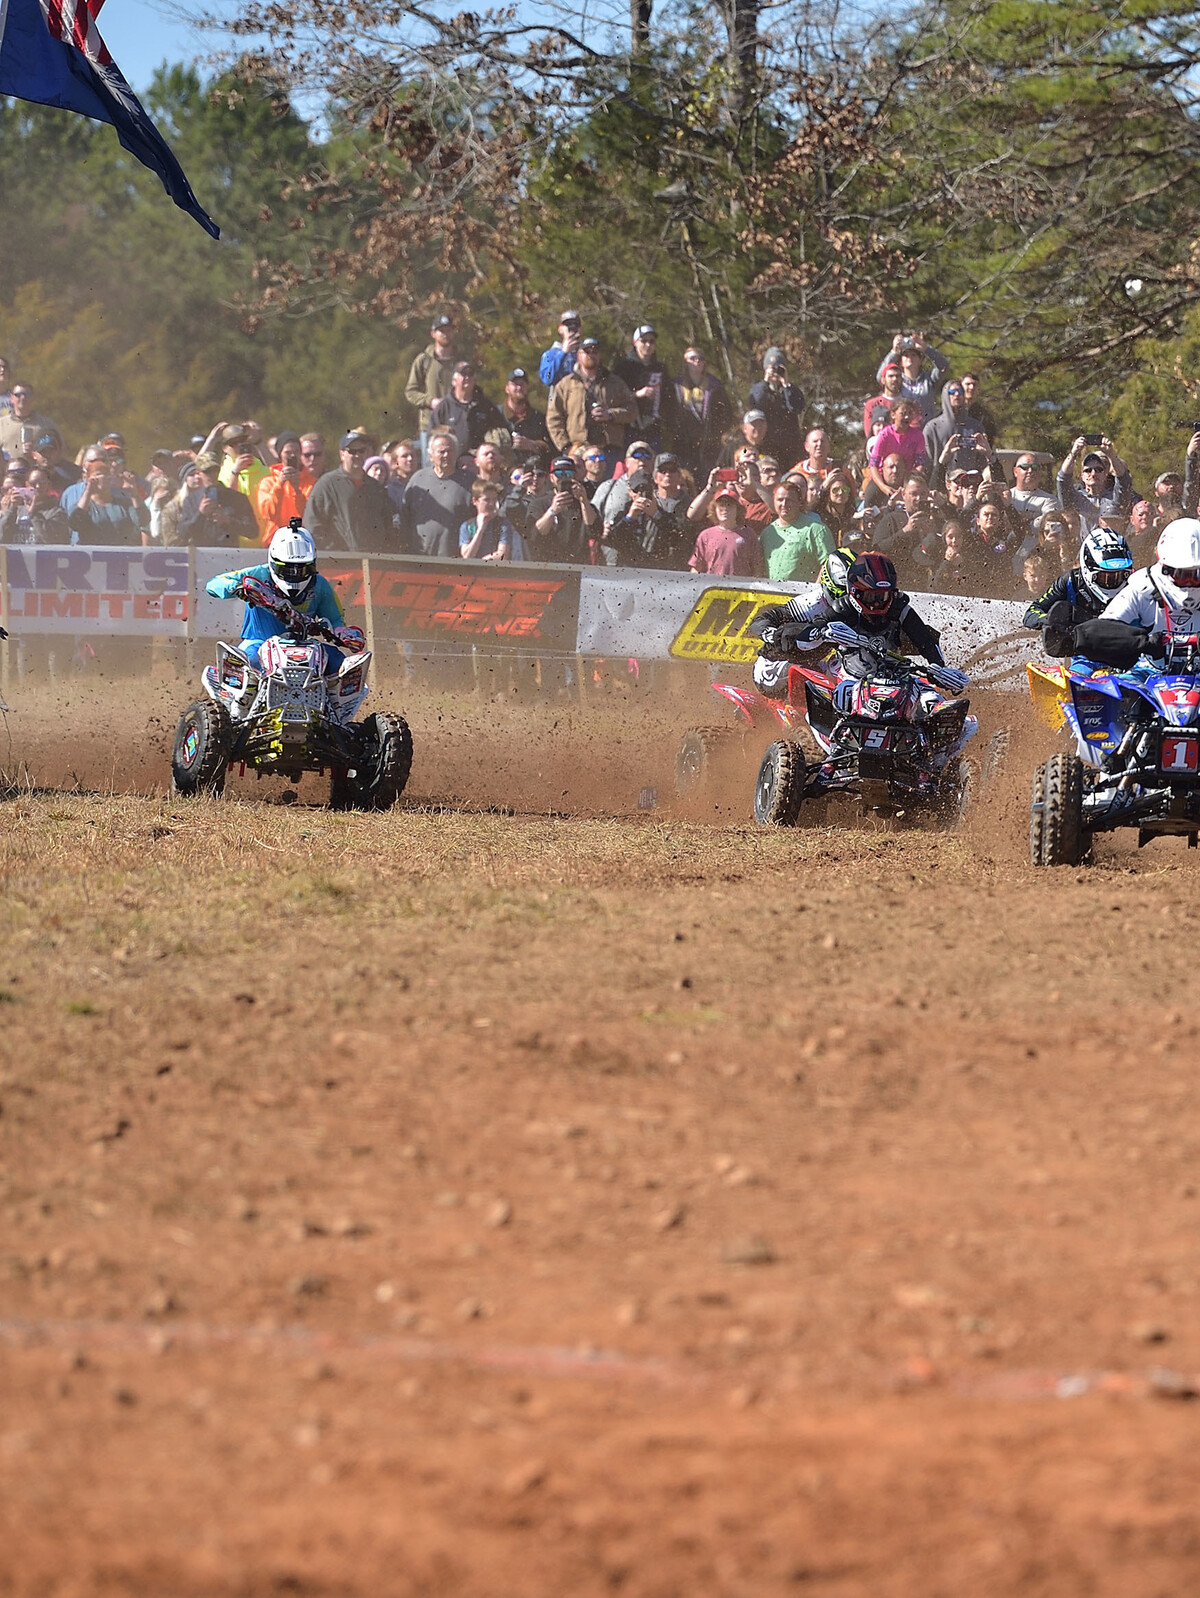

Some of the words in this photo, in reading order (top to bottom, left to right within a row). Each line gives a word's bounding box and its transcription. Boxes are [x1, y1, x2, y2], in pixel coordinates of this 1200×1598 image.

[1171, 690, 1193, 705] 1
[865, 729, 888, 748] 5
[1170, 741, 1188, 768] 1
